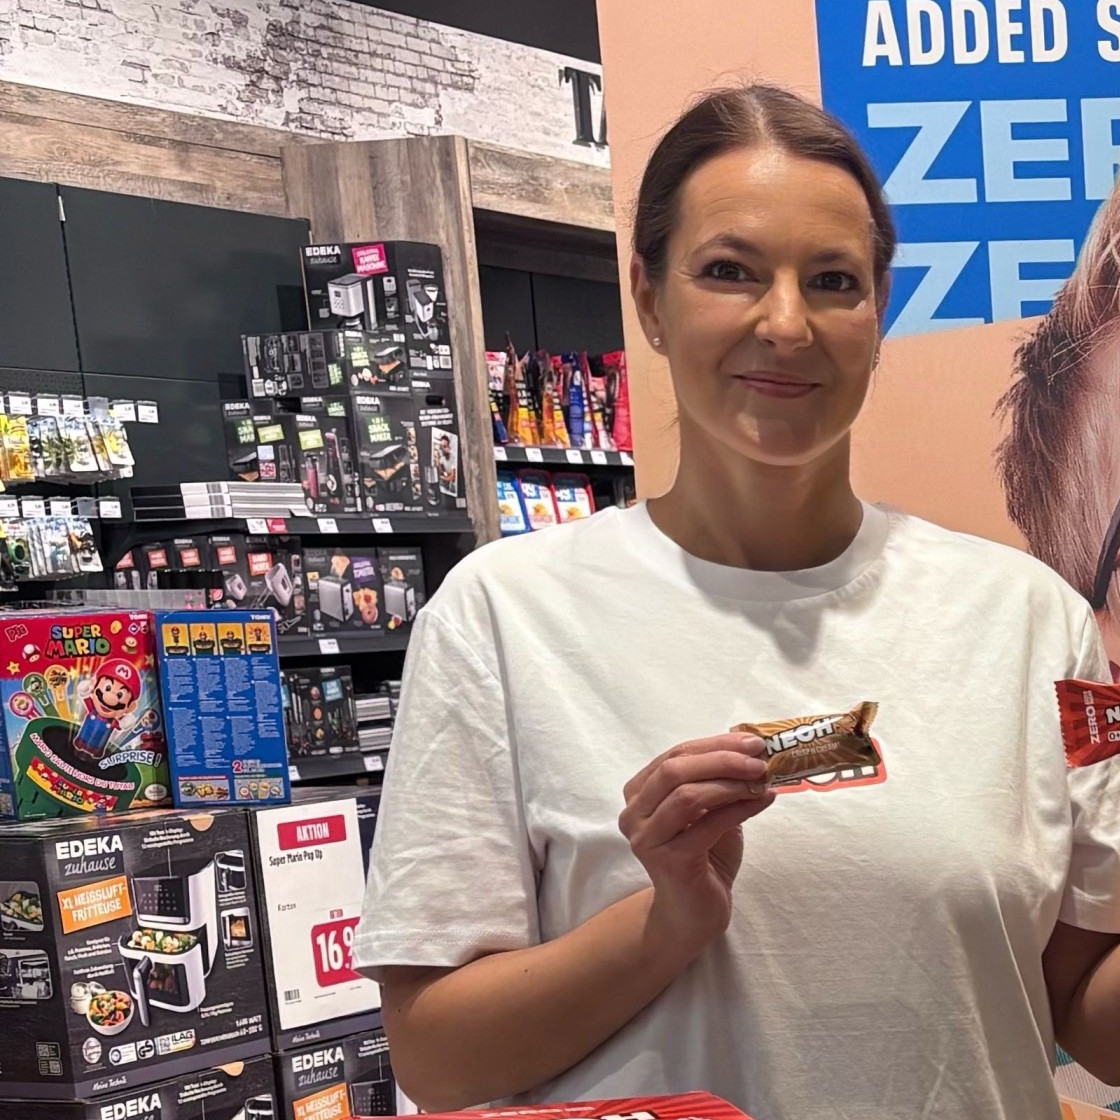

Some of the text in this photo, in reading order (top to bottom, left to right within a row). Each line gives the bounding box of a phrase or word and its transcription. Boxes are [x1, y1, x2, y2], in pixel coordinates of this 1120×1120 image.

[862, 0, 1068, 67] ADDED
[51, 624, 101, 640] SUPER
[45, 638, 110, 658] MARIO
[1085, 706, 1101, 745] ZERO
[99, 751, 154, 770] SURPRISE
[296, 822, 330, 843] AKTION
[55, 834, 124, 860] EDEKA
[64, 855, 117, 877] zuhause
[291, 1046, 345, 1073] EDEKA
[298, 1066, 339, 1087] zuhause
